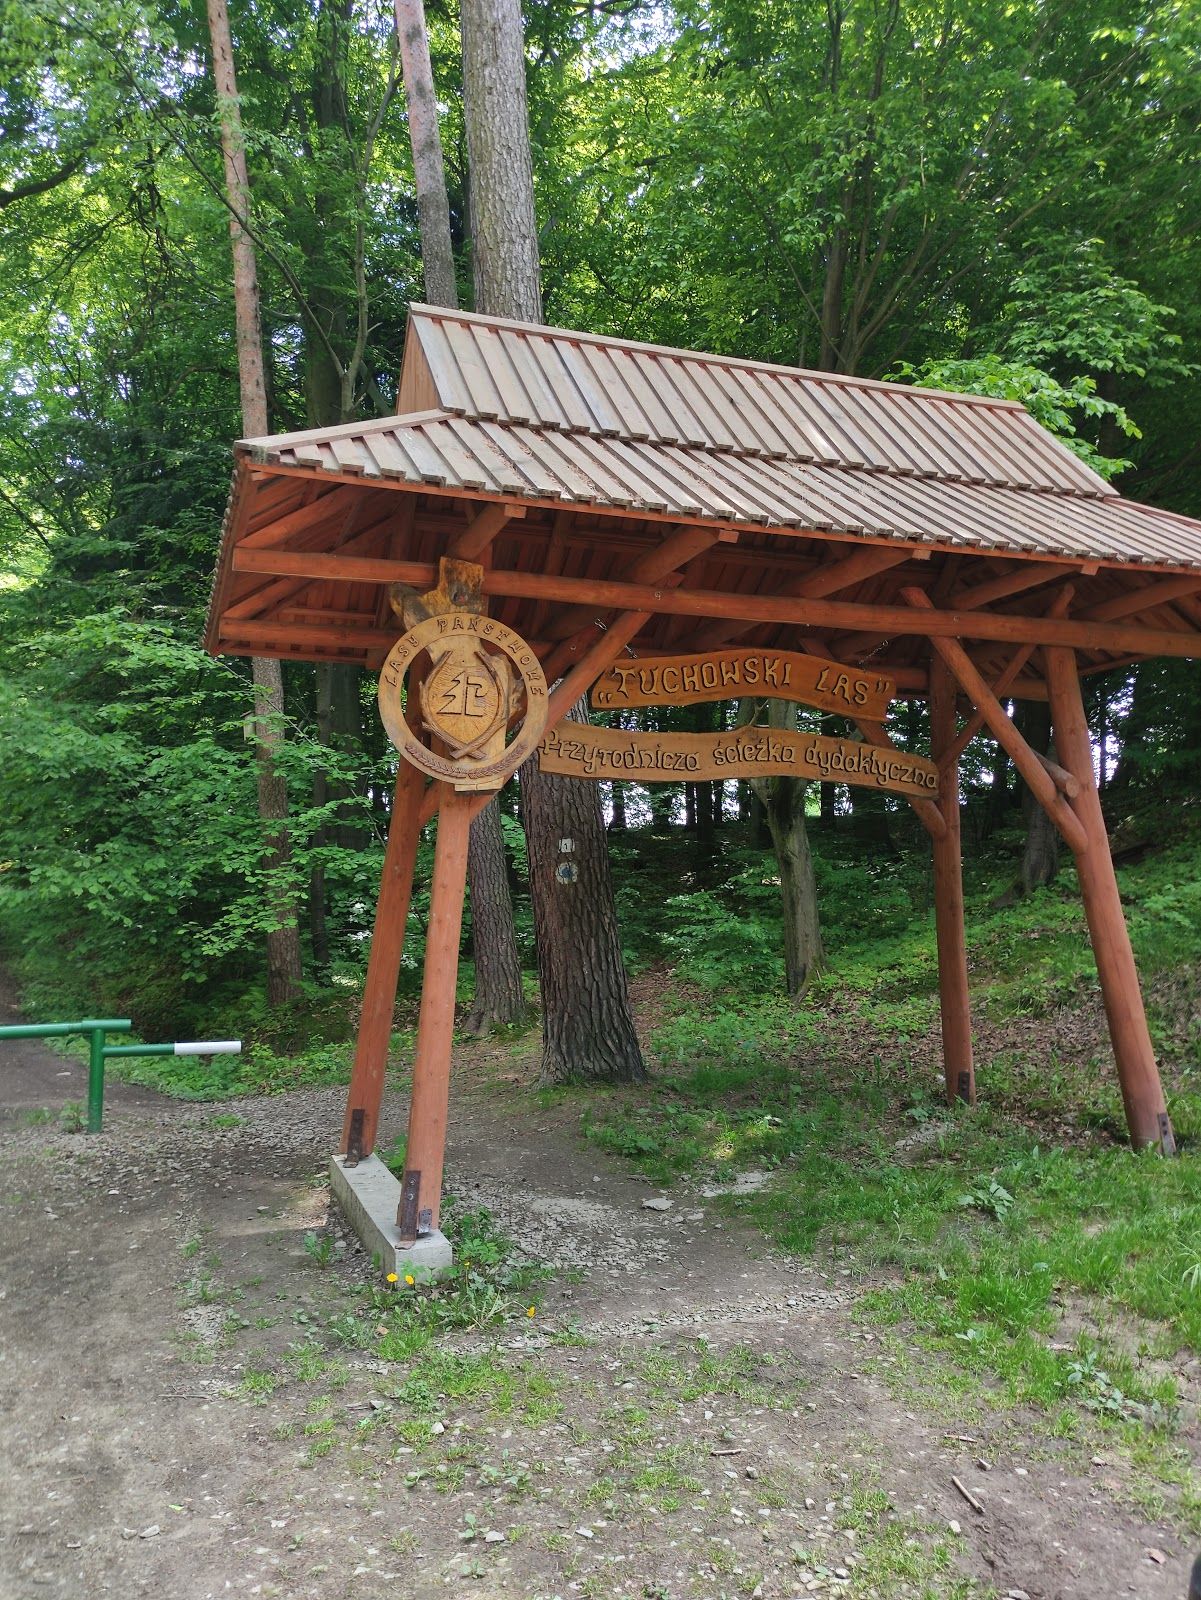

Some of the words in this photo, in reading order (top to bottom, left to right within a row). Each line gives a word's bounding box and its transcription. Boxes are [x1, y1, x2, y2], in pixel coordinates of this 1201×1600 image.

[384, 634, 420, 688] LASY
[537, 728, 702, 774] Przyrodnicza
[713, 736, 797, 766] ścieżka
[804, 739, 939, 789] dydaktyczna
